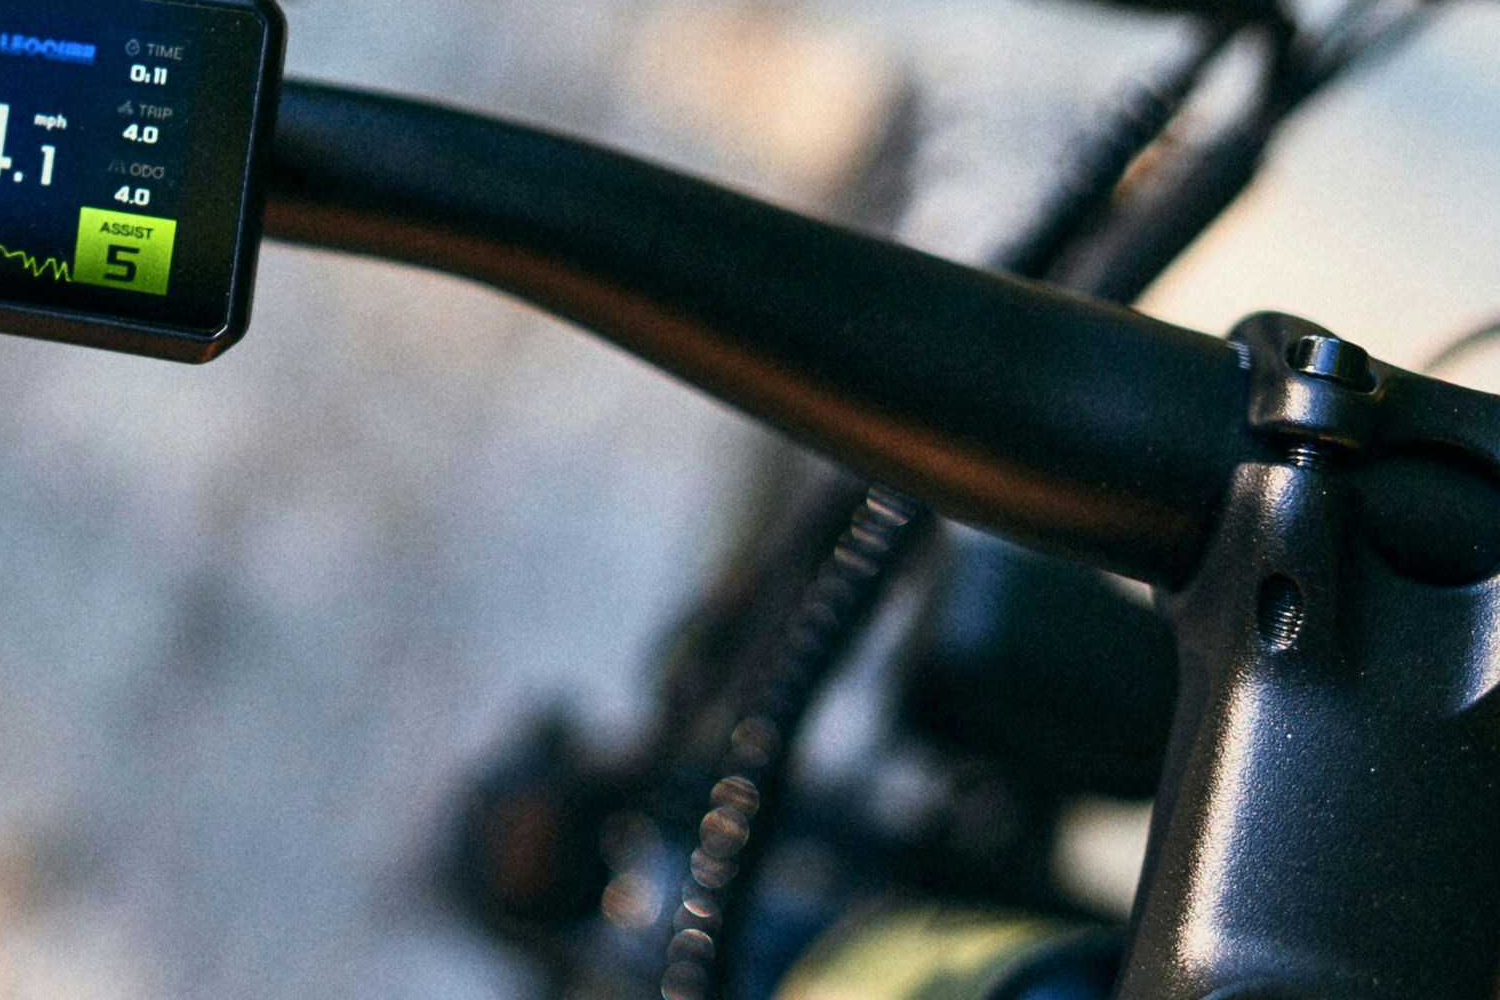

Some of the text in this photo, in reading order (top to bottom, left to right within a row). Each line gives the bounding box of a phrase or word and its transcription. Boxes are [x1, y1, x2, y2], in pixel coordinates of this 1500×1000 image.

[147, 43, 183, 61] TIME
[130, 64, 168, 85] 0:11
[139, 104, 173, 120] TRIP
[34, 113, 68, 131] mph
[122, 123, 160, 144] 4.0
[130, 163, 165, 180] ODO
[114, 185, 151, 206] 4.0
[100, 222, 155, 241] ASSIST
[103, 244, 141, 284] 5
